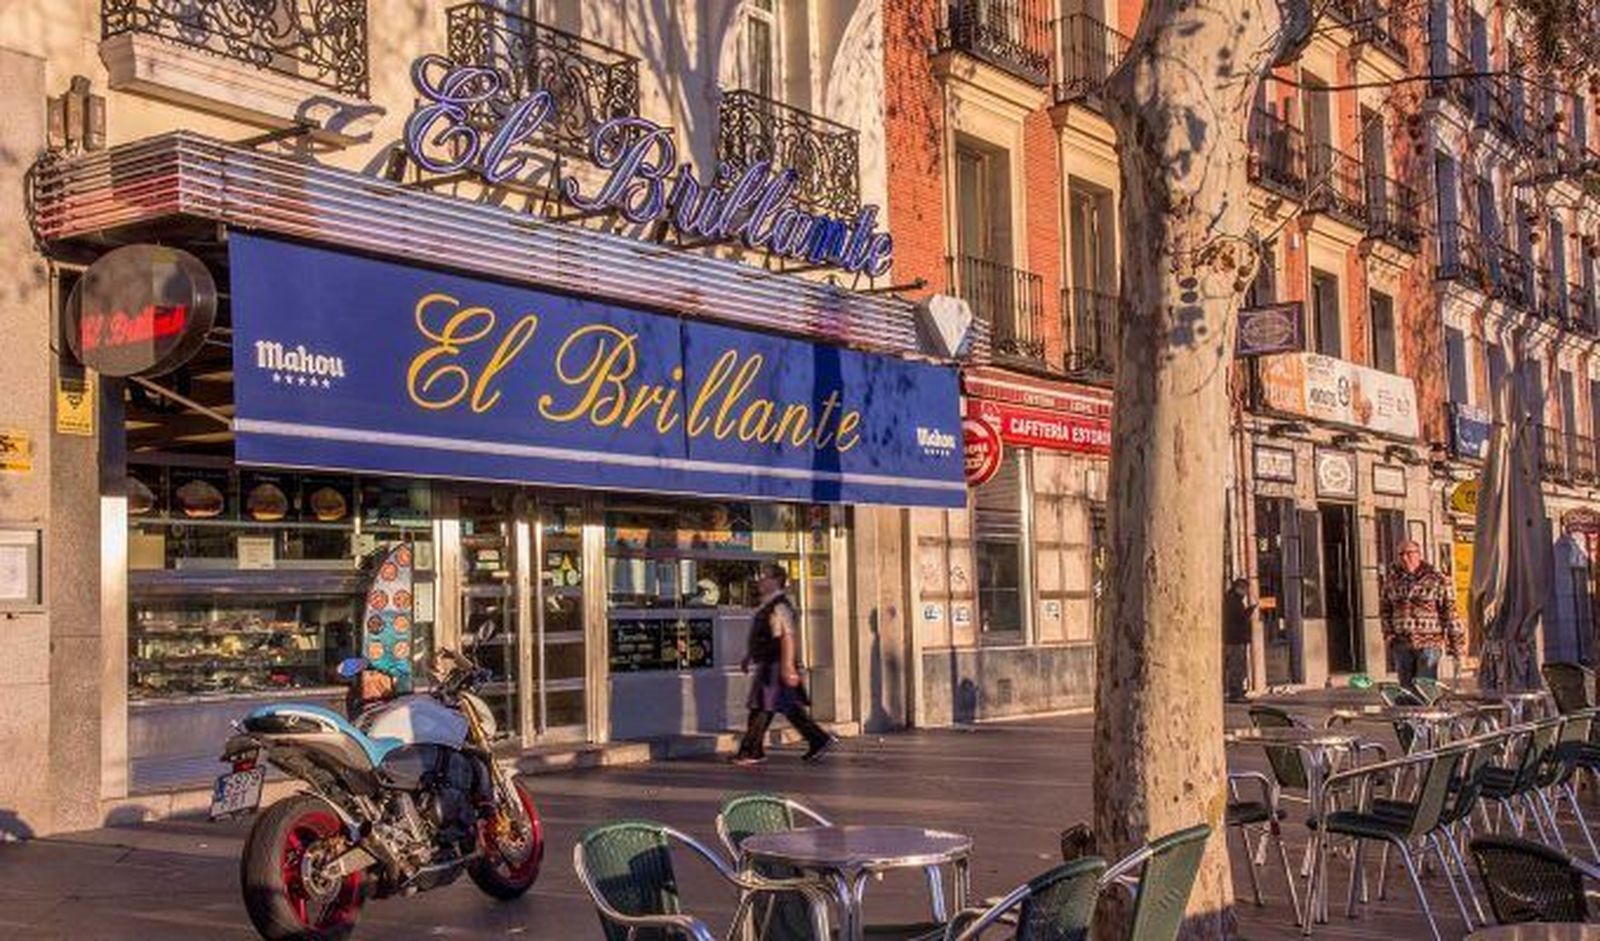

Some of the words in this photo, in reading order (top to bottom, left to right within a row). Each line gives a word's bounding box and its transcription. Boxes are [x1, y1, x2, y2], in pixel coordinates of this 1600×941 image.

[402, 53, 555, 183] El
[565, 115, 894, 278] Brillante
[255, 340, 346, 378] Mahou
[406, 293, 538, 414] El
[538, 323, 862, 452] Brillante
